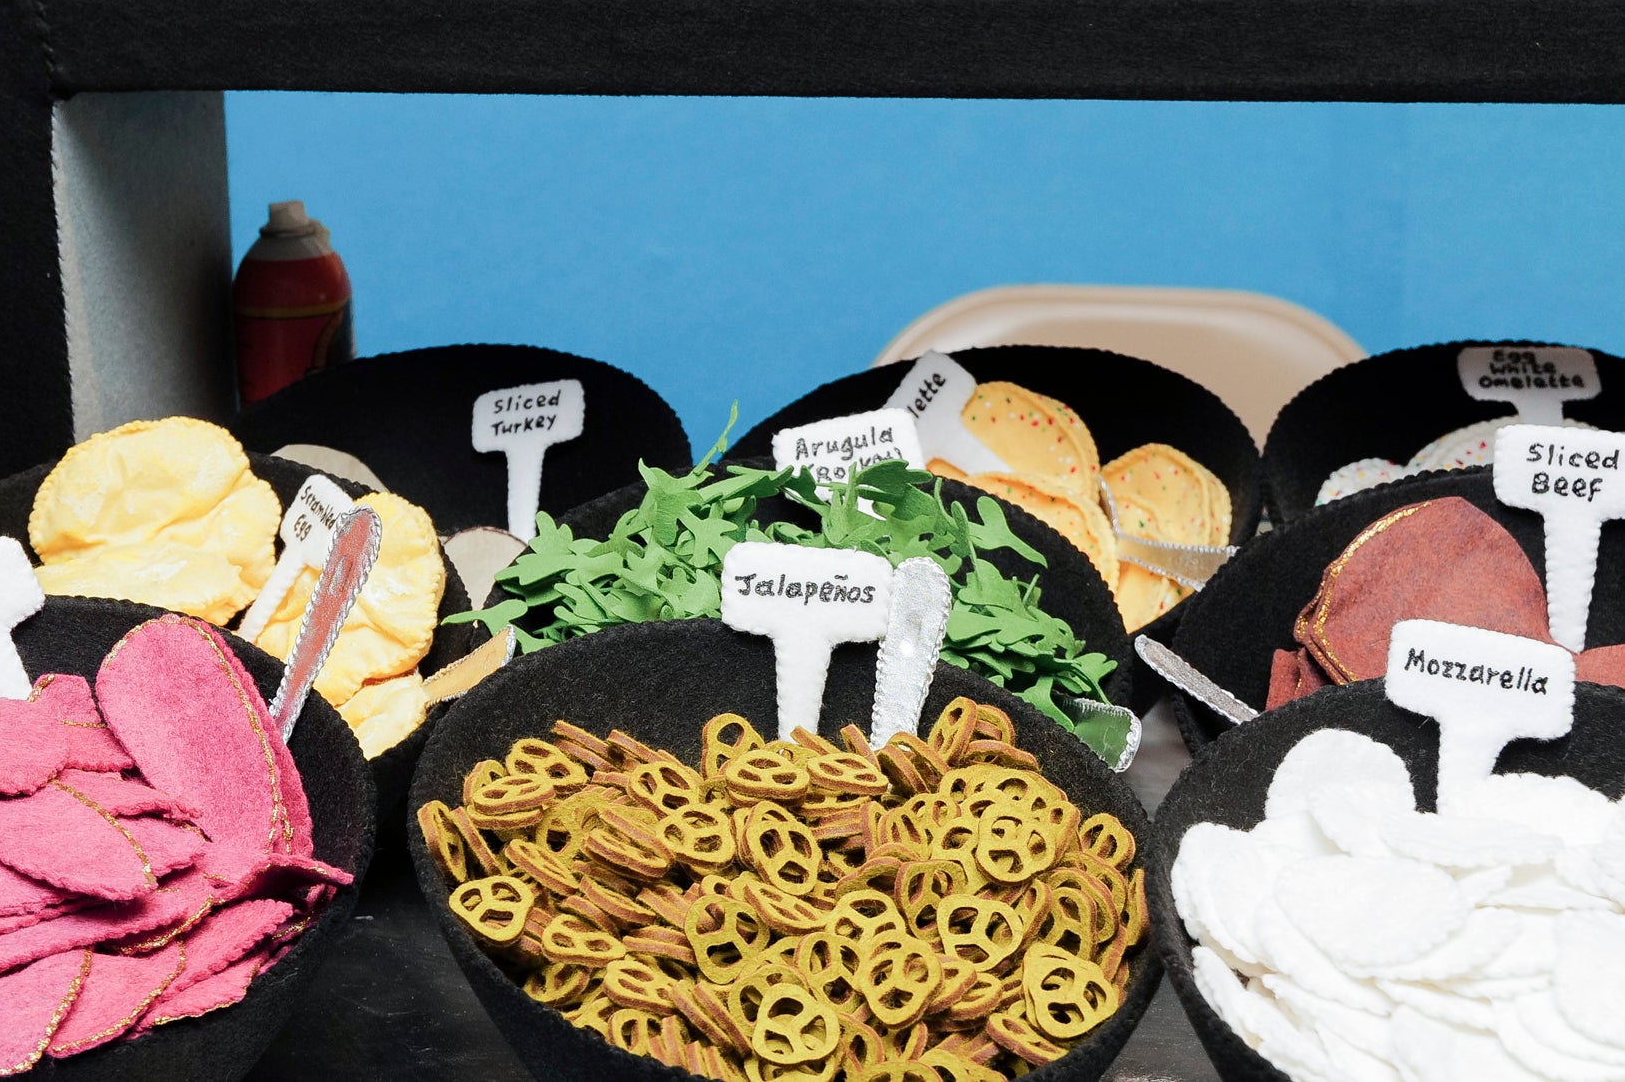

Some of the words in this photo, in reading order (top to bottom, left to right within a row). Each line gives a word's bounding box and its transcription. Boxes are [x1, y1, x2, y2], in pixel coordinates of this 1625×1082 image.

[494, 391, 561, 415] Sliced
[906, 373, 947, 419] lette
[796, 426, 894, 461] Arugula
[1526, 442, 1622, 471] Sliced
[1531, 472, 1604, 502] Beef
[293, 513, 313, 542] Egg
[734, 573, 876, 606] Jalapeños
[1403, 648, 1550, 697] Mozzarella
